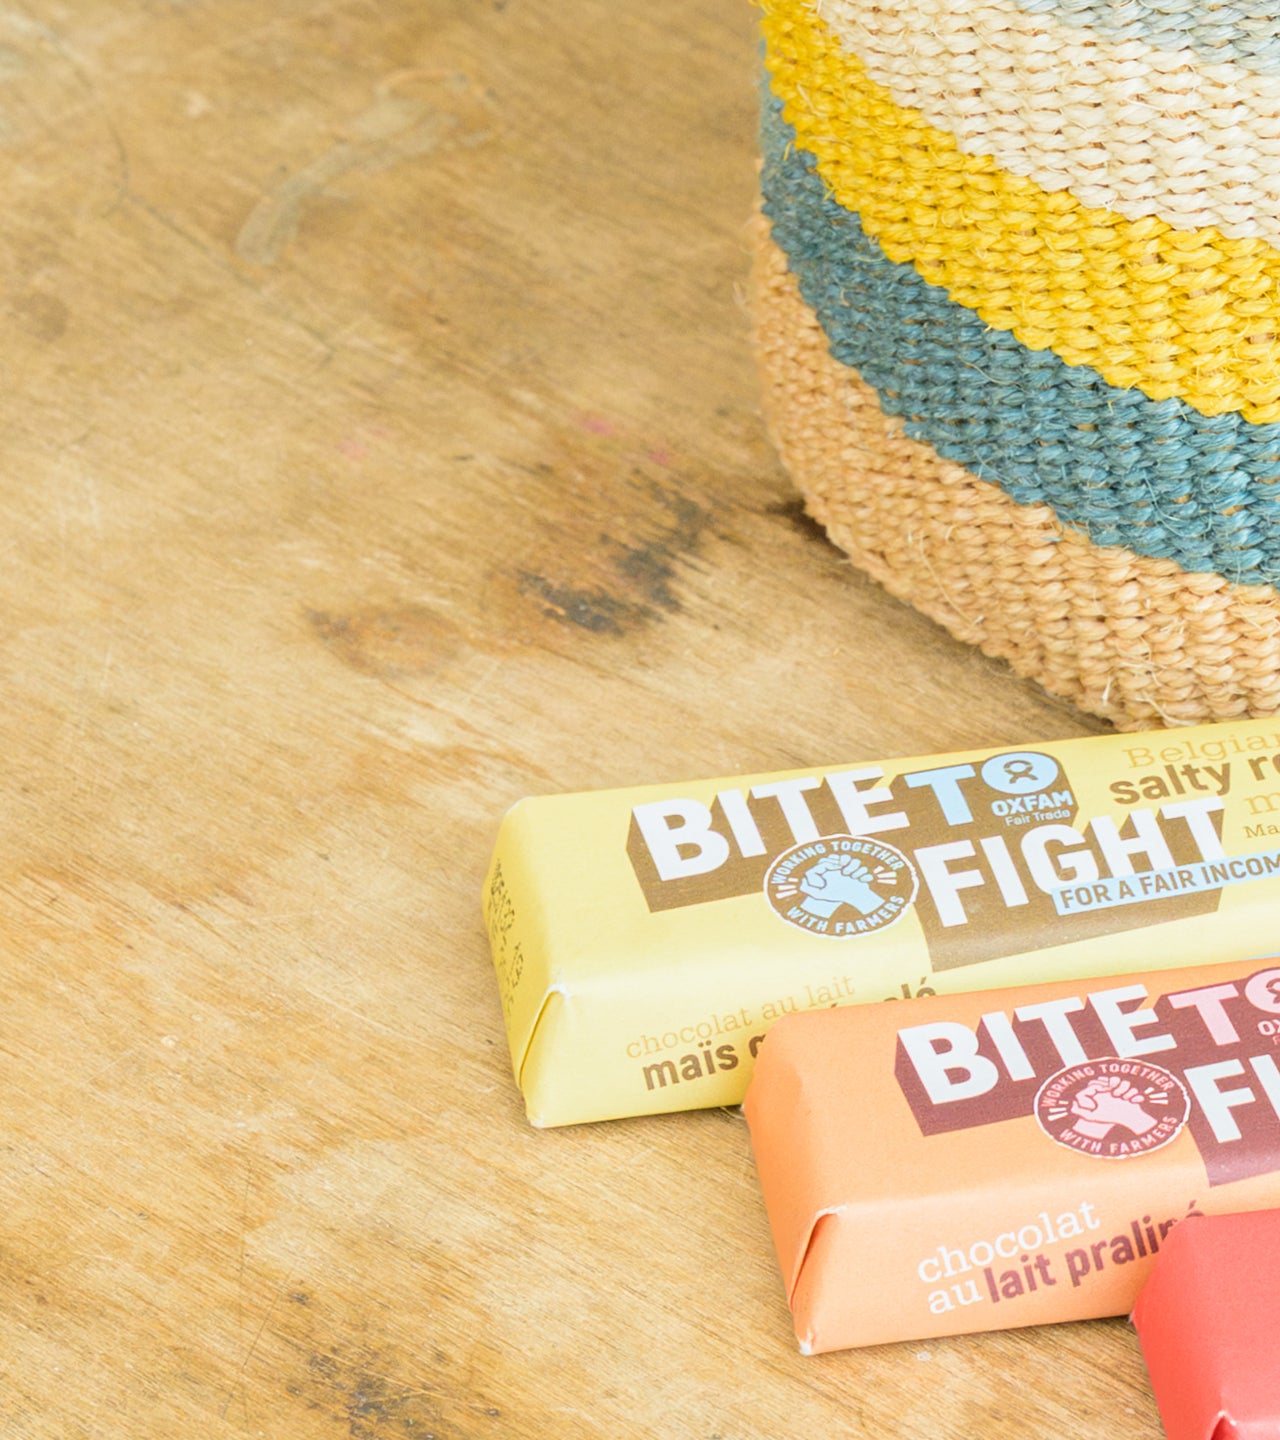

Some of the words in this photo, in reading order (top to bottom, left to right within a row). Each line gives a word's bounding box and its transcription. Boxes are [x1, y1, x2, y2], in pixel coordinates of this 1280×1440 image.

[991, 791, 1074, 818] OXFAM
[1109, 760, 1232, 805] salty
[631, 767, 910, 881] BITE
[770, 841, 828, 885] WORKING
[830, 841, 905, 876] TOGETHER
[913, 796, 1226, 927] FIGHT
[1060, 886, 1114, 909] FOR
[1117, 876, 1136, 899] A
[1140, 865, 1197, 895] FAIR
[785, 905, 829, 935] WITH
[834, 893, 904, 935] FARMERS
[626, 1004, 752, 1060] chocolat
[760, 994, 798, 1020] au
[805, 975, 855, 1008] lait
[643, 1039, 738, 1091] maïs
[898, 983, 1177, 1105] BITE
[1040, 1065, 1095, 1108] WORKING
[1099, 1063, 1174, 1091] TOGETHER
[1058, 1127, 1103, 1154] WITH
[1108, 1115, 1177, 1155] FARMERS
[917, 1202, 1099, 1284] chocolat
[928, 1281, 983, 1314] au
[984, 1251, 1056, 1304] lait
